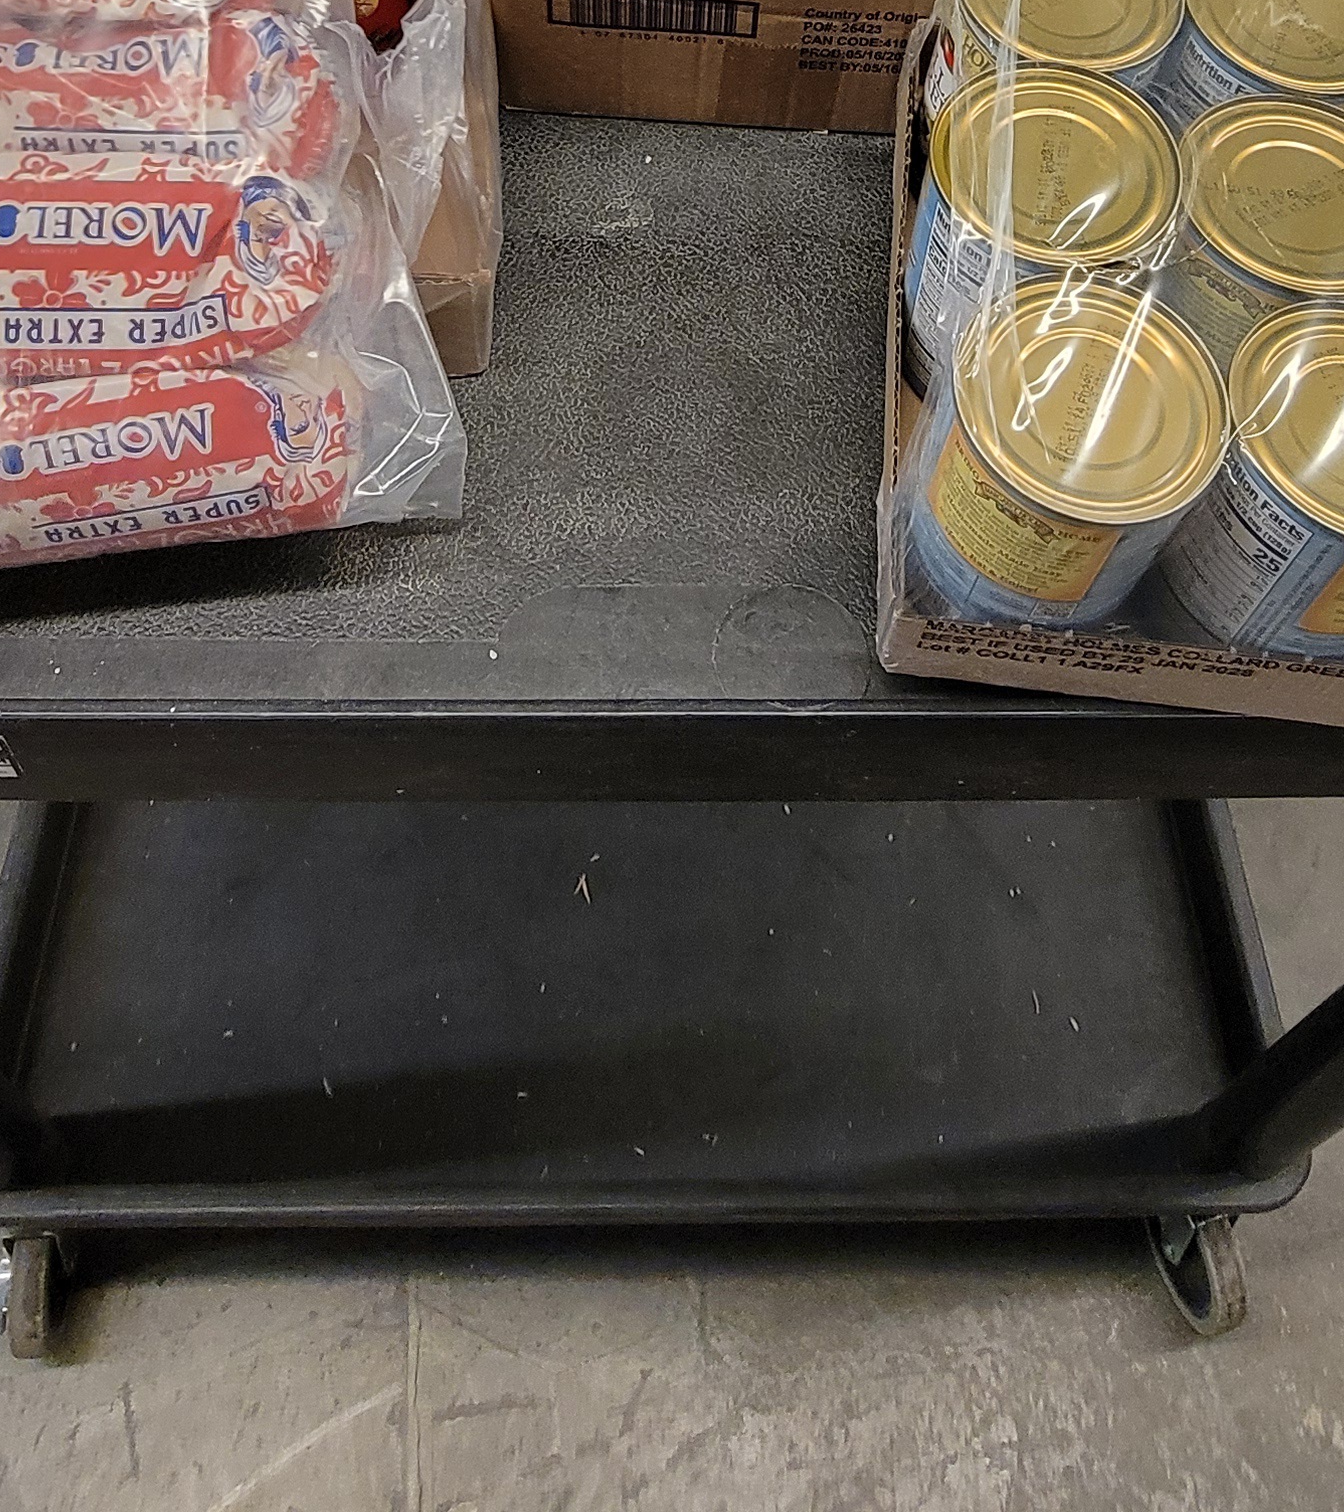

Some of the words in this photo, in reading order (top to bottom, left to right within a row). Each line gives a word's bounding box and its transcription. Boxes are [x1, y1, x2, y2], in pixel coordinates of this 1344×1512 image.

[802, 21, 839, 34] PO#:
[841, 22, 883, 35] 26423
[804, 7, 863, 21] Country
[865, 10, 882, 20] of
[801, 34, 834, 46] CAN
[797, 59, 838, 72] BEST
[1185, 41, 1241, 97] Nutrition
[4, 316, 106, 345] EXTRA
[128, 304, 219, 344] SUPER
[163, 495, 262, 526] SUPER
[1259, 497, 1307, 543] Facts
[45, 517, 145, 543] EXTRA
[1252, 546, 1281, 574] 25
[916, 640, 951, 654] Lot
[955, 644, 971, 656] #
[920, 632, 979, 647] BEST
[986, 639, 1008, 649] IF
[1012, 641, 1077, 658] USED
[1081, 650, 1117, 662] BY
[1150, 658, 1198, 672] JAN
[1062, 637, 1162, 656] HOLMES
[1166, 647, 1281, 671] COLLARD
